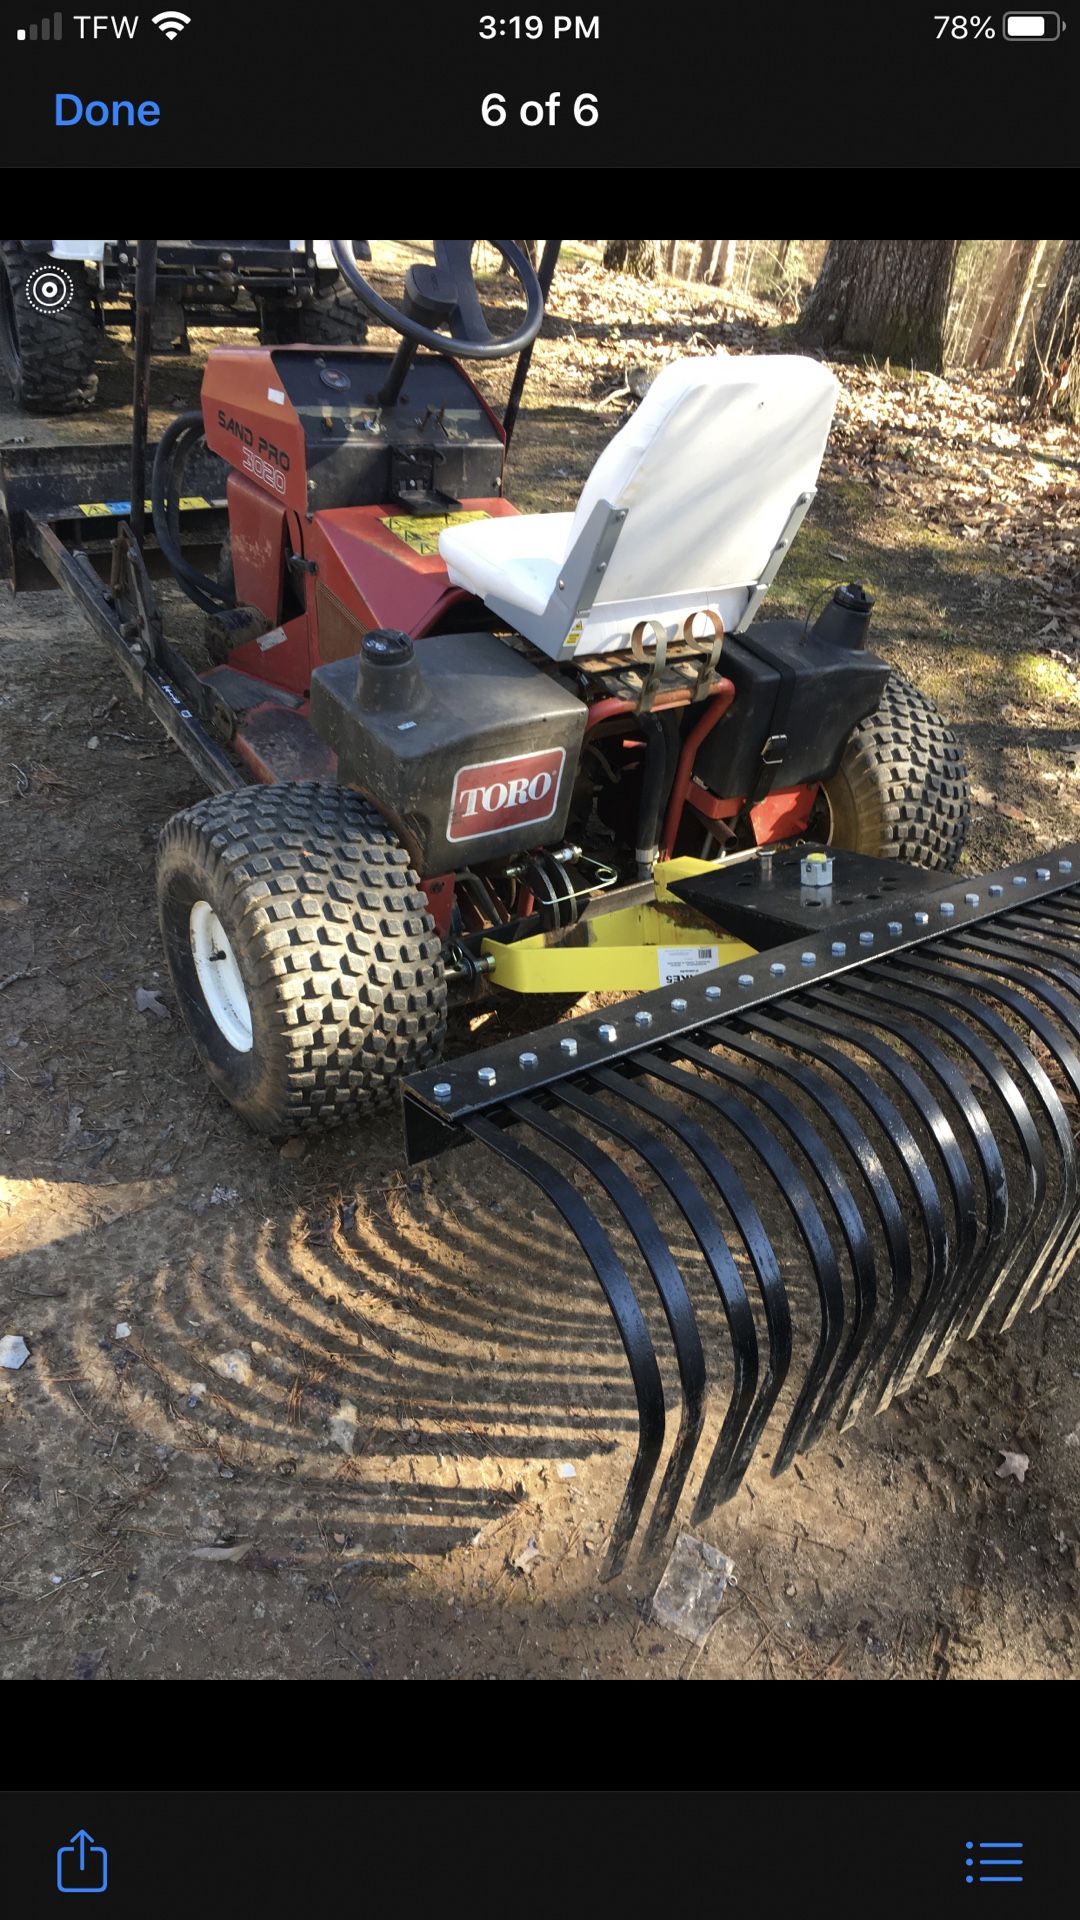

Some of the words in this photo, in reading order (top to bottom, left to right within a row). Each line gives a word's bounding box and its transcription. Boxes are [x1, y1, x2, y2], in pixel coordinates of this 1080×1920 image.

[218, 410, 253, 447] SAND
[259, 436, 290, 471] PRO
[242, 446, 286, 495] 3020
[459, 772, 552, 818] TORO
